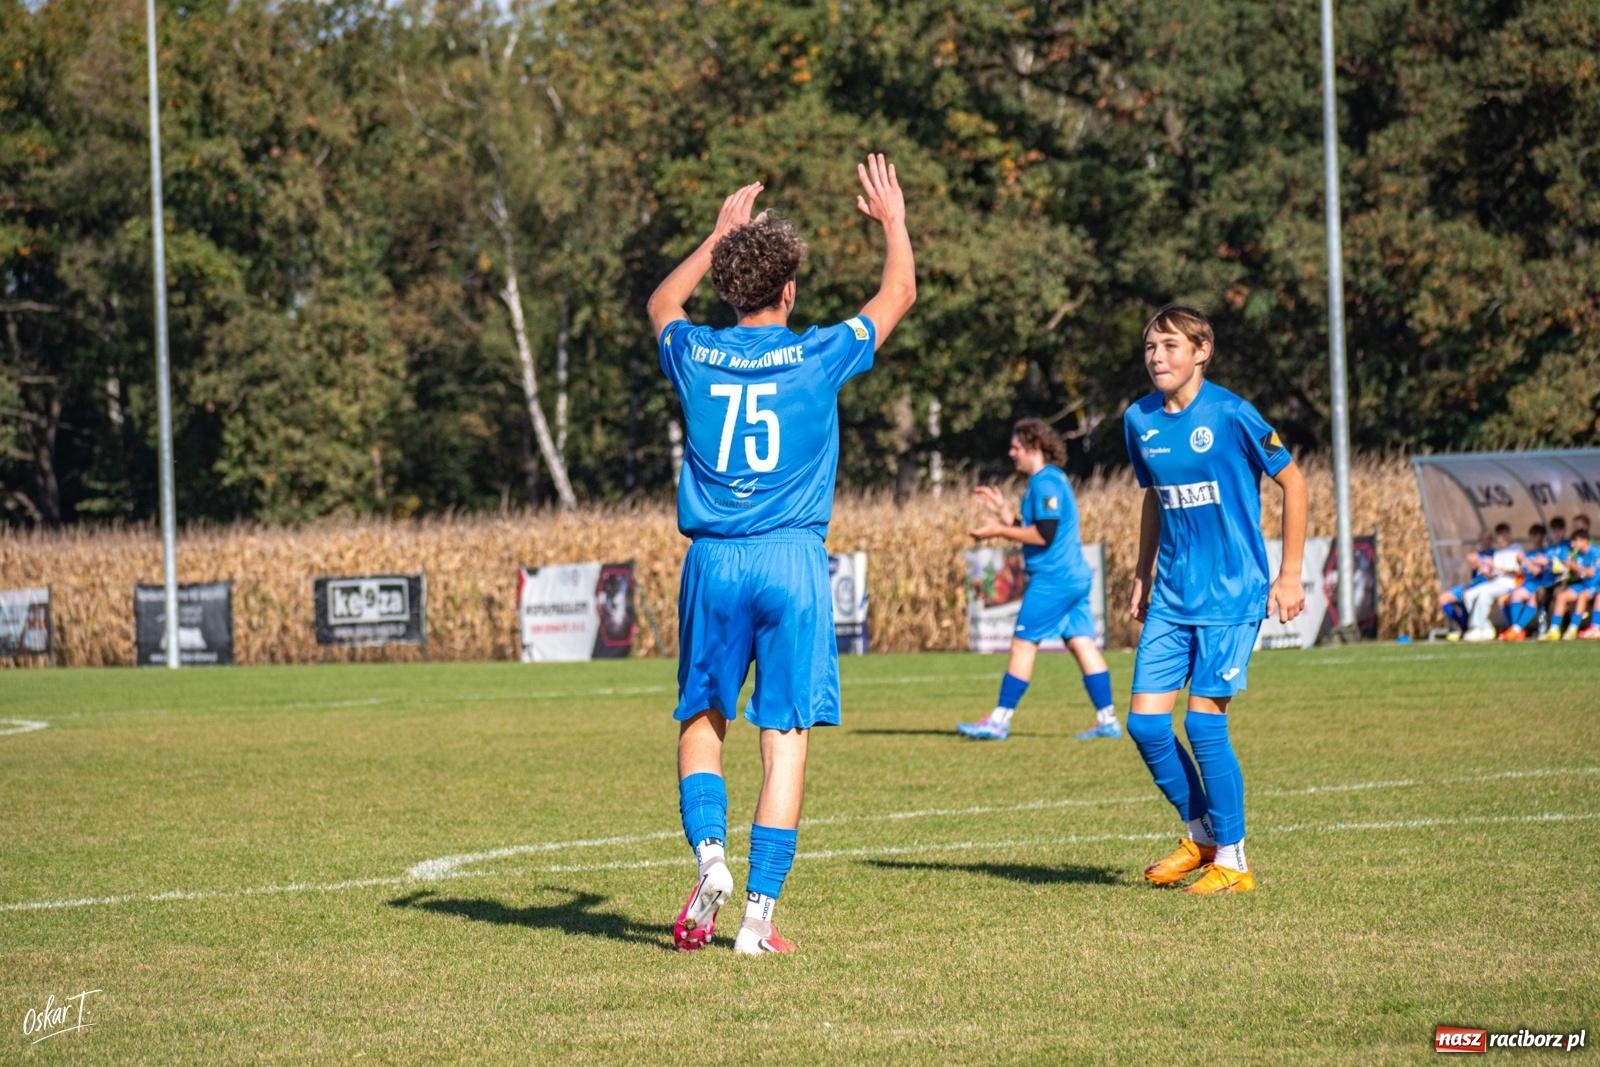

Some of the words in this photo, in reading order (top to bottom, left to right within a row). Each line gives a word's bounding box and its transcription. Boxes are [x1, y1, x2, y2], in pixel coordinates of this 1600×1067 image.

[709, 349, 726, 366] 07
[729, 345, 804, 369] MARKOWICE
[710, 382, 780, 473] 75
